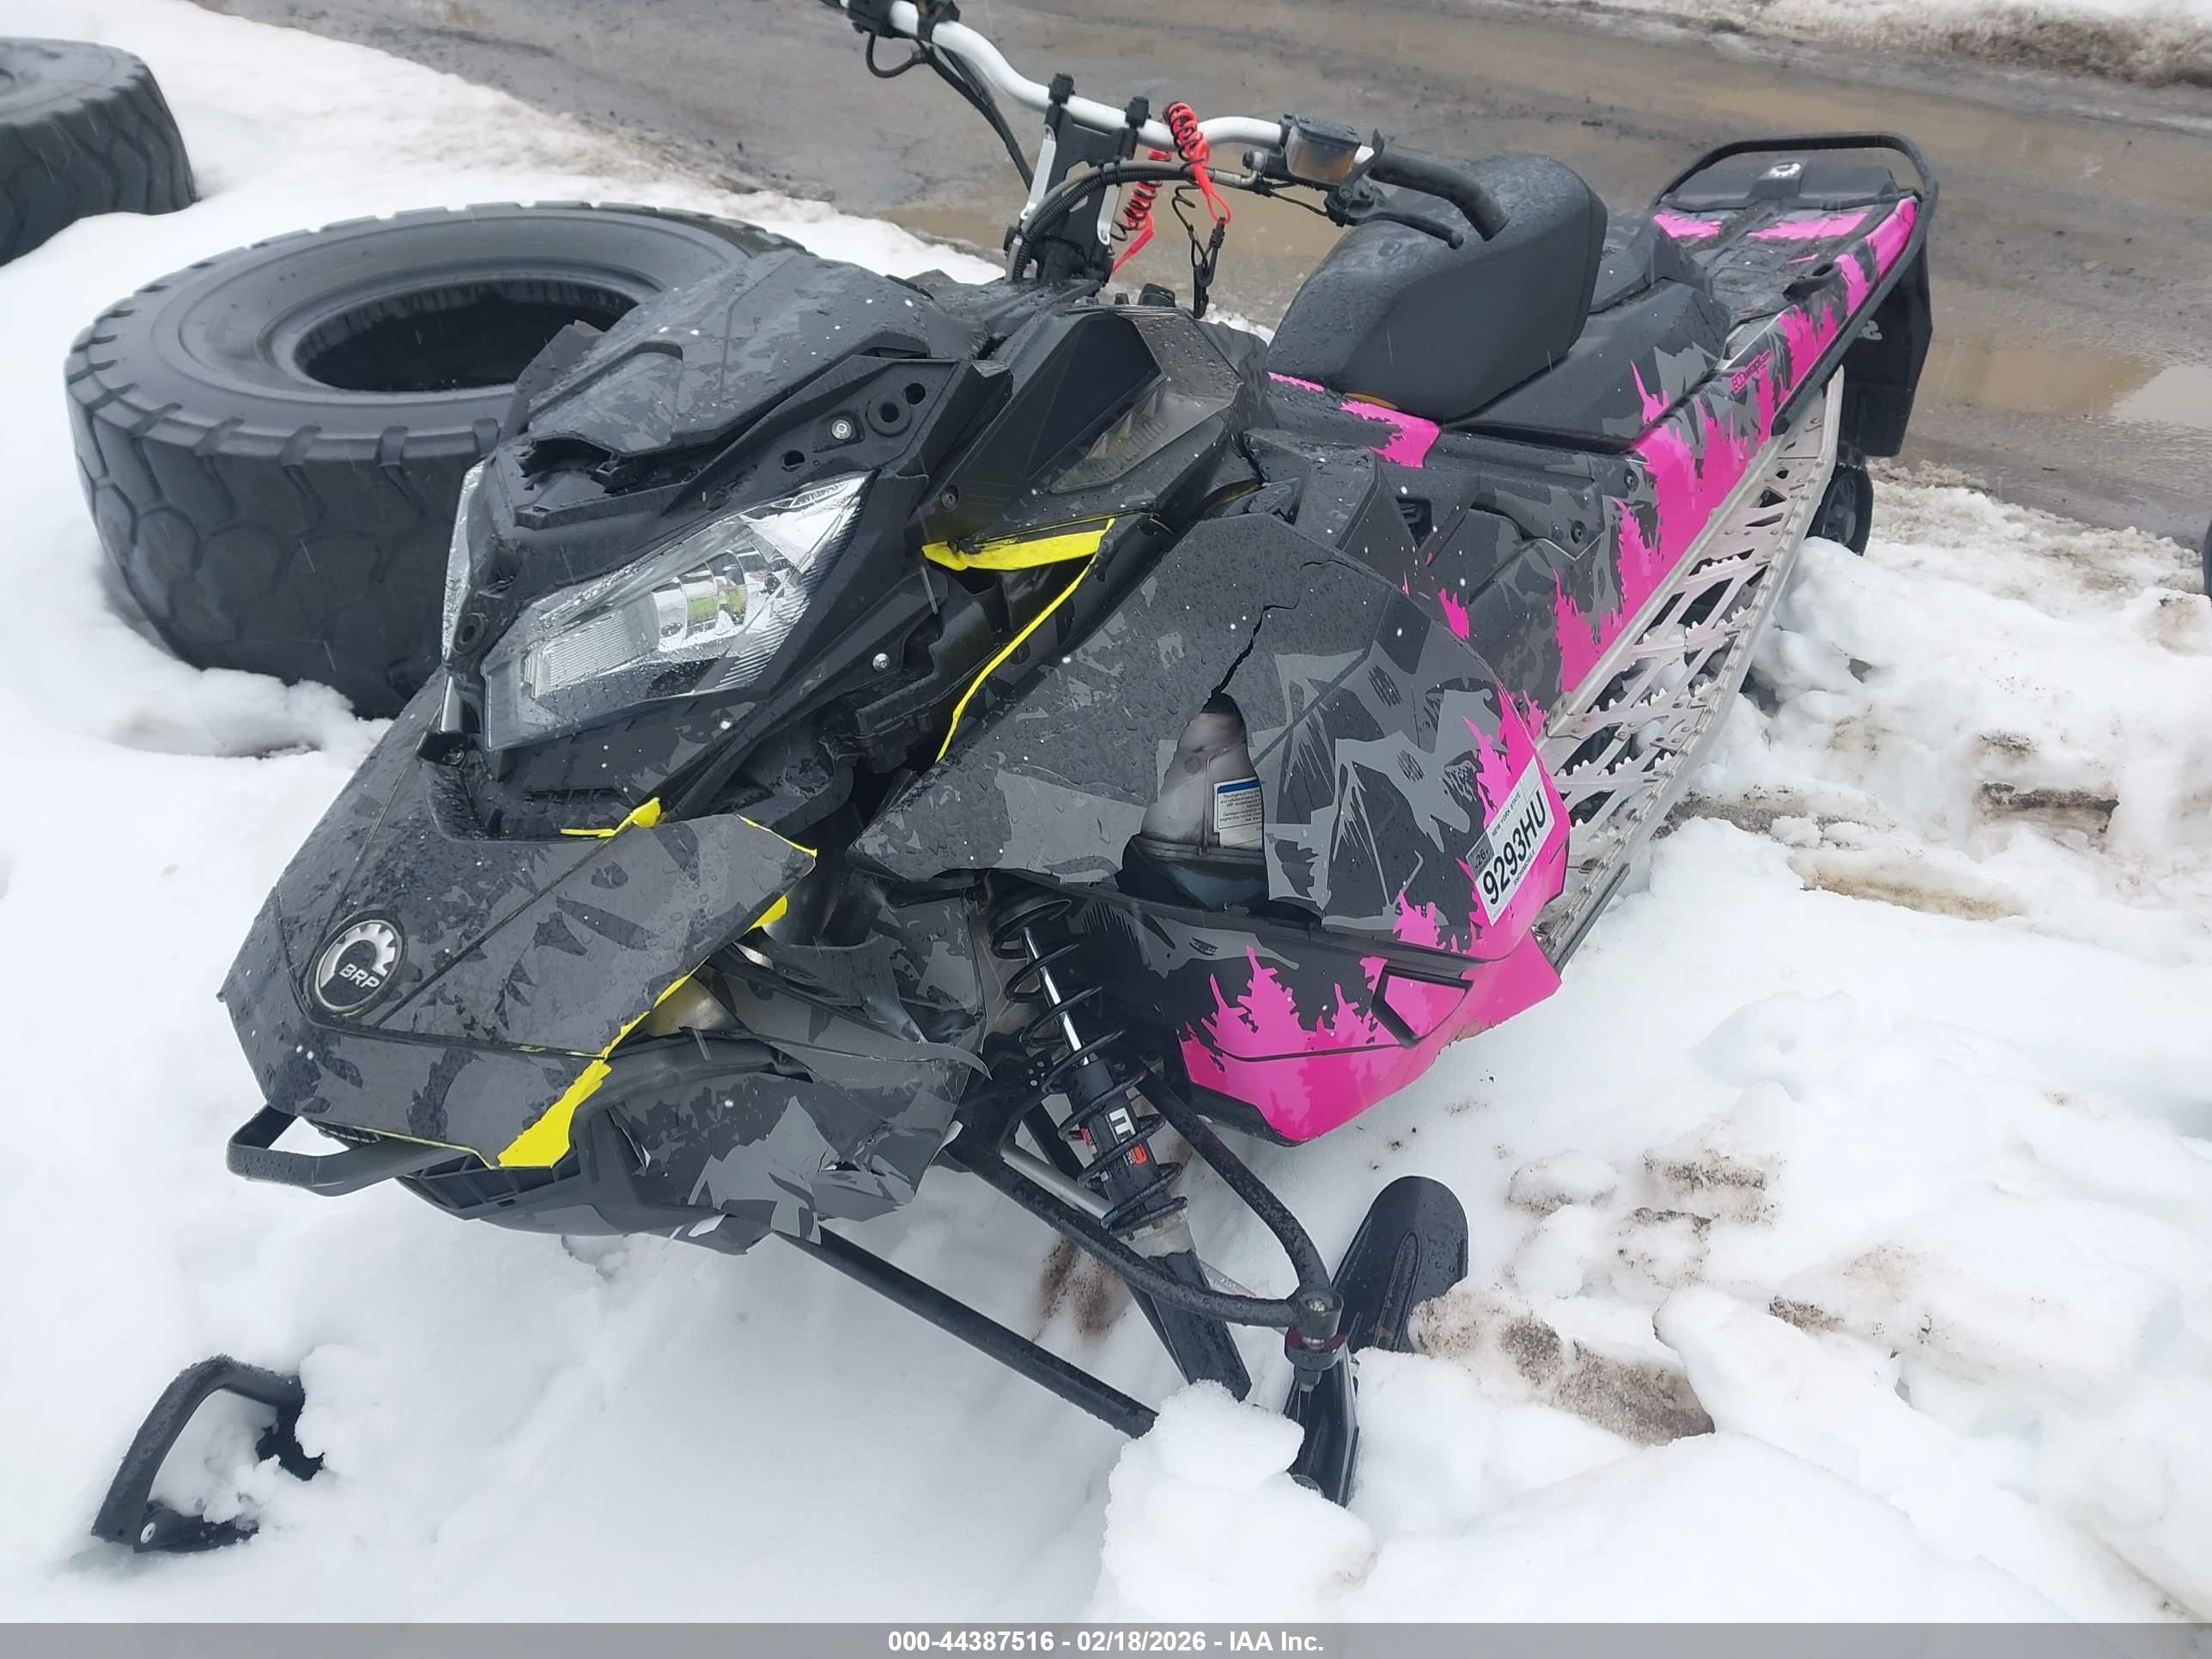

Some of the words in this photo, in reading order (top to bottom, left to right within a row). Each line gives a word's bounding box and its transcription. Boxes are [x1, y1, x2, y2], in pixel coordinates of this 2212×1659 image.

[1492, 823, 1502, 837] NEW
[1501, 810, 1511, 824] YORK
[1510, 792, 1522, 810] STATE
[1475, 848, 1486, 866] 26
[1482, 789, 1547, 905] 9293HU
[338, 963, 380, 988] BRP
